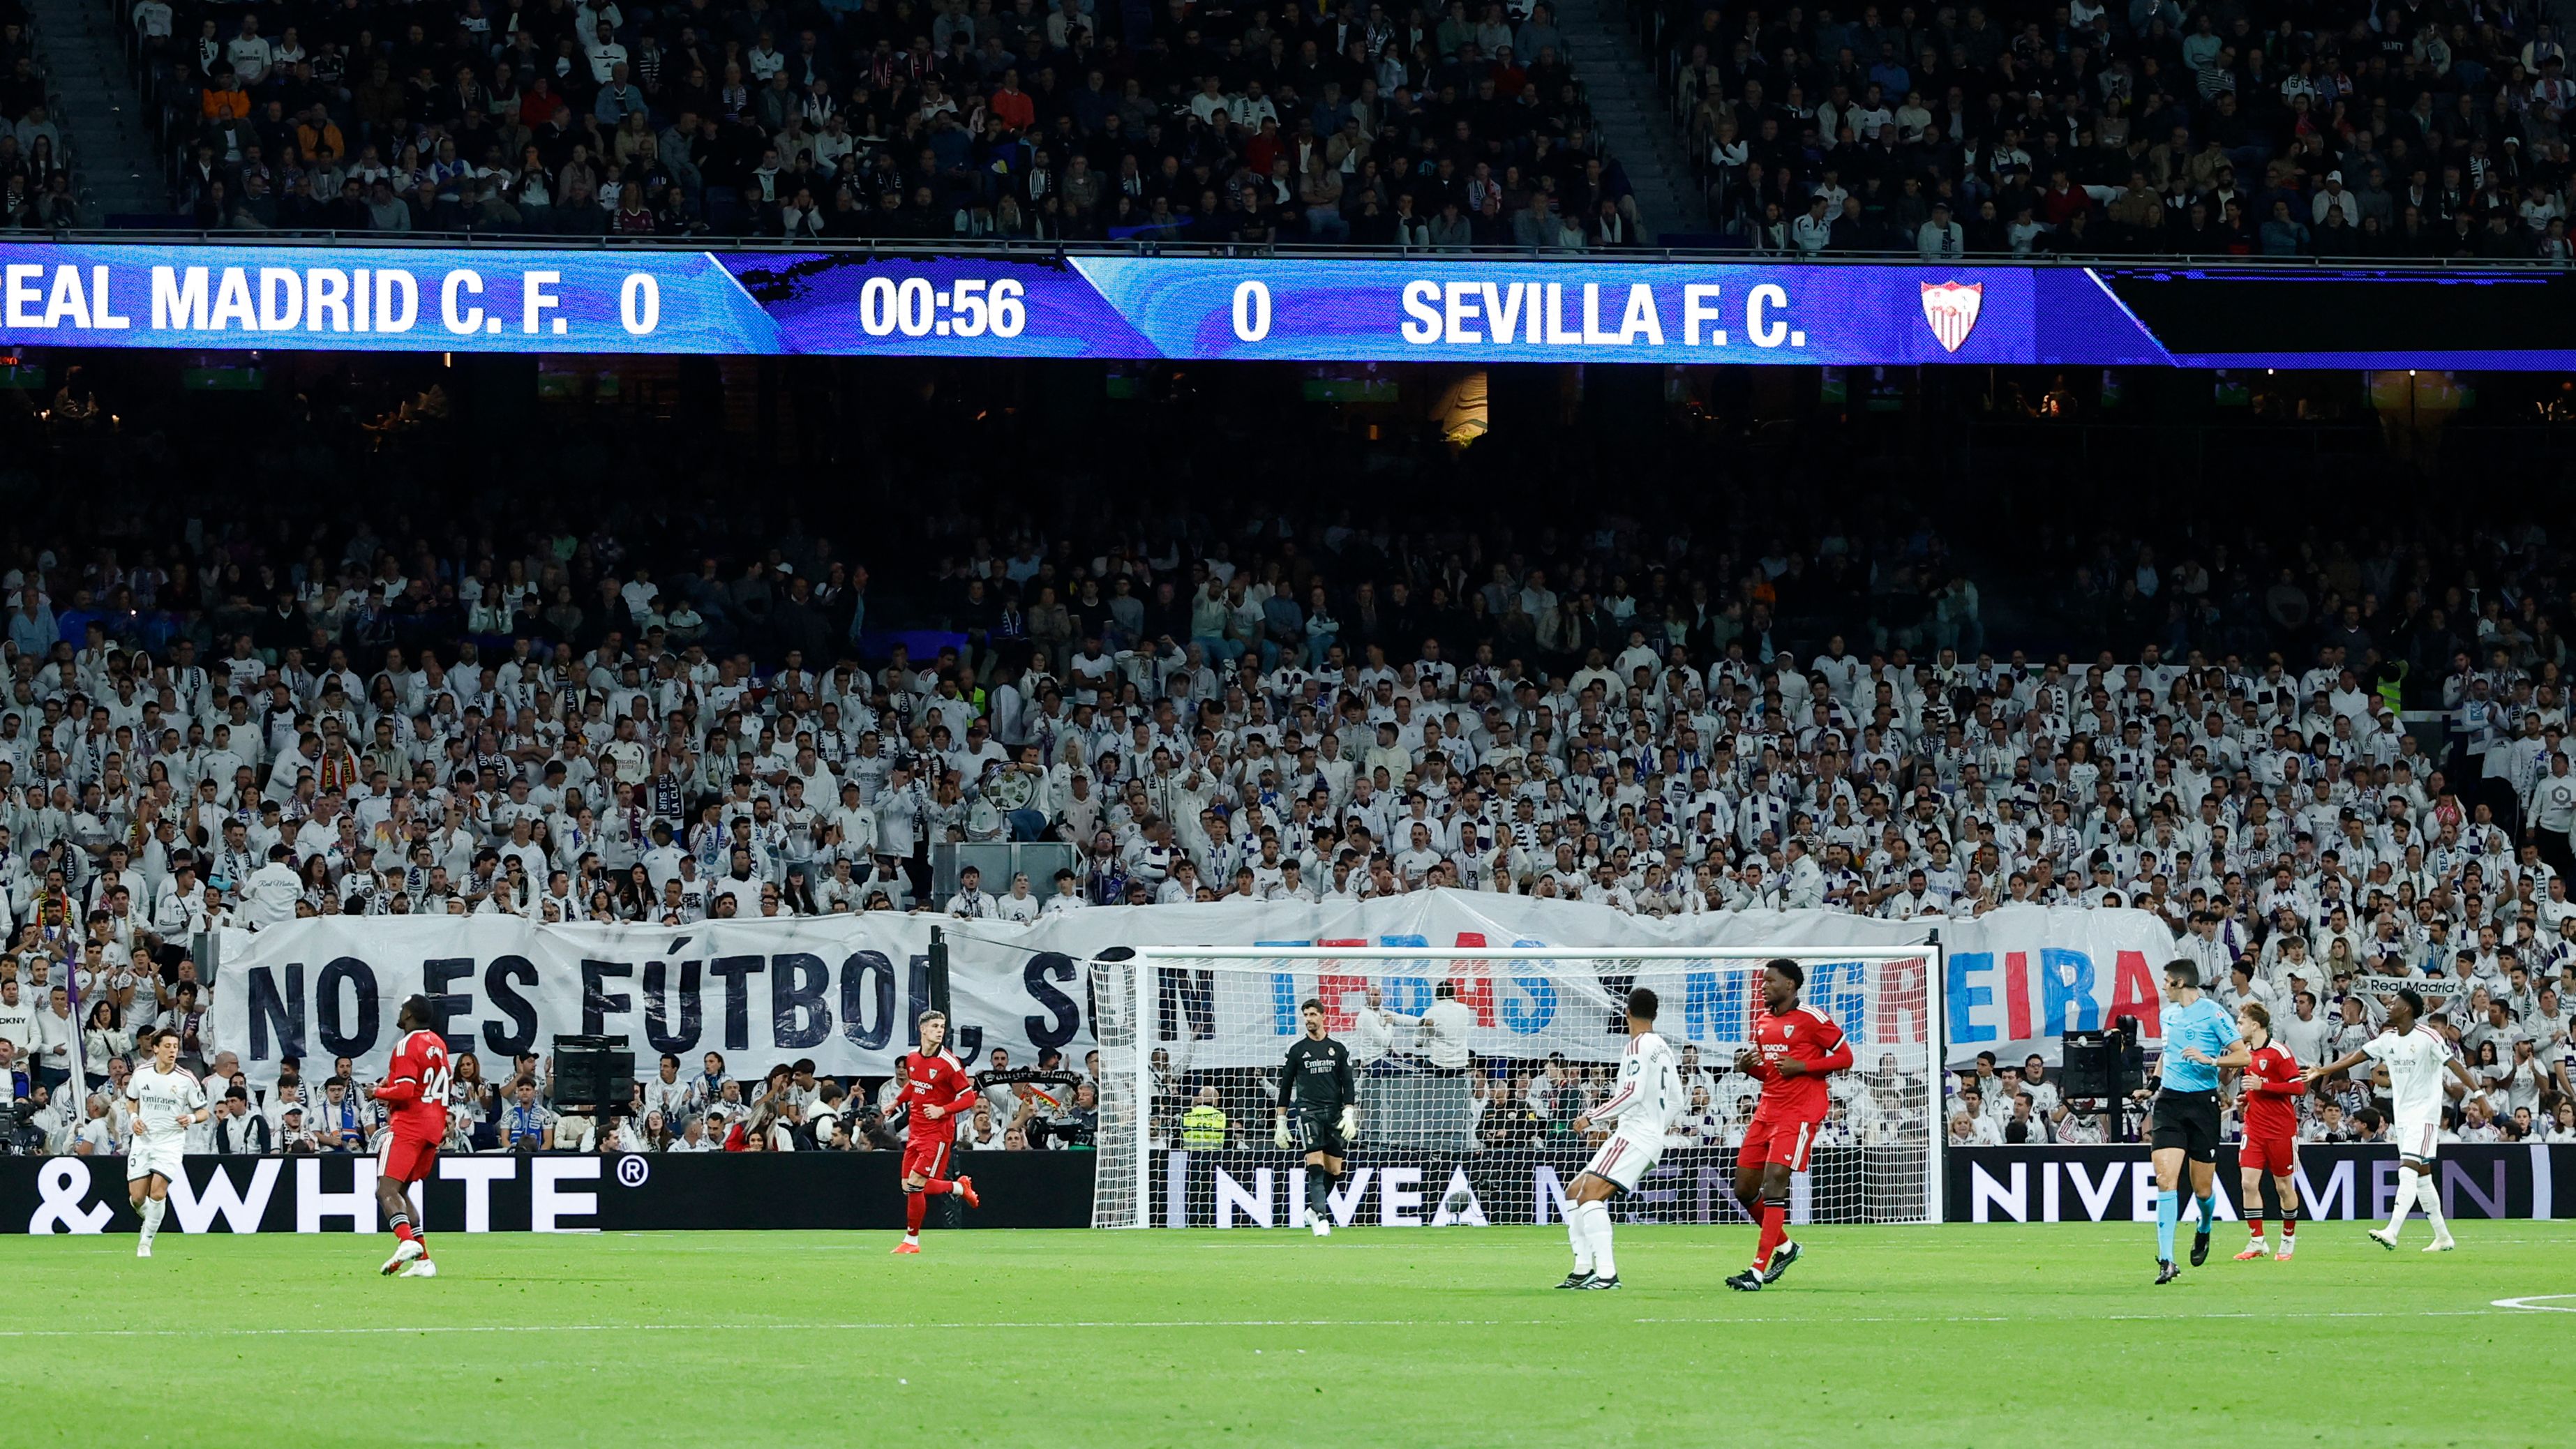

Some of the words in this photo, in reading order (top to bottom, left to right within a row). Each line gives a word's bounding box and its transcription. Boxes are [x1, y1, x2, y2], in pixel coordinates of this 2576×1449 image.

[0, 264, 130, 329] EAL
[151, 266, 419, 332] MADRID
[441, 270, 502, 335] C.
[523, 271, 567, 335] F.
[620, 273, 660, 335] 0
[860, 277, 1026, 339] 00:56
[1232, 280, 1272, 342] 0
[1401, 279, 1665, 346] SEVILLA
[1685, 284, 1727, 346] F.
[1746, 284, 1806, 347] C.
[248, 956, 381, 1060] NO
[423, 954, 539, 1058] ES
[1253, 932, 1557, 1035] TEBAS
[2372, 979, 2402, 991] Real
[2412, 979, 2456, 993] Madrid
[421, 1066, 450, 1107] 24
[1303, 1058, 1336, 1069] Emirates
[142, 1094, 176, 1107] Emirates
[1216, 1164, 1488, 1229] NIVEA
[1972, 1162, 2238, 1223] NIVEA
[2291, 1159, 2505, 1222] MEN
